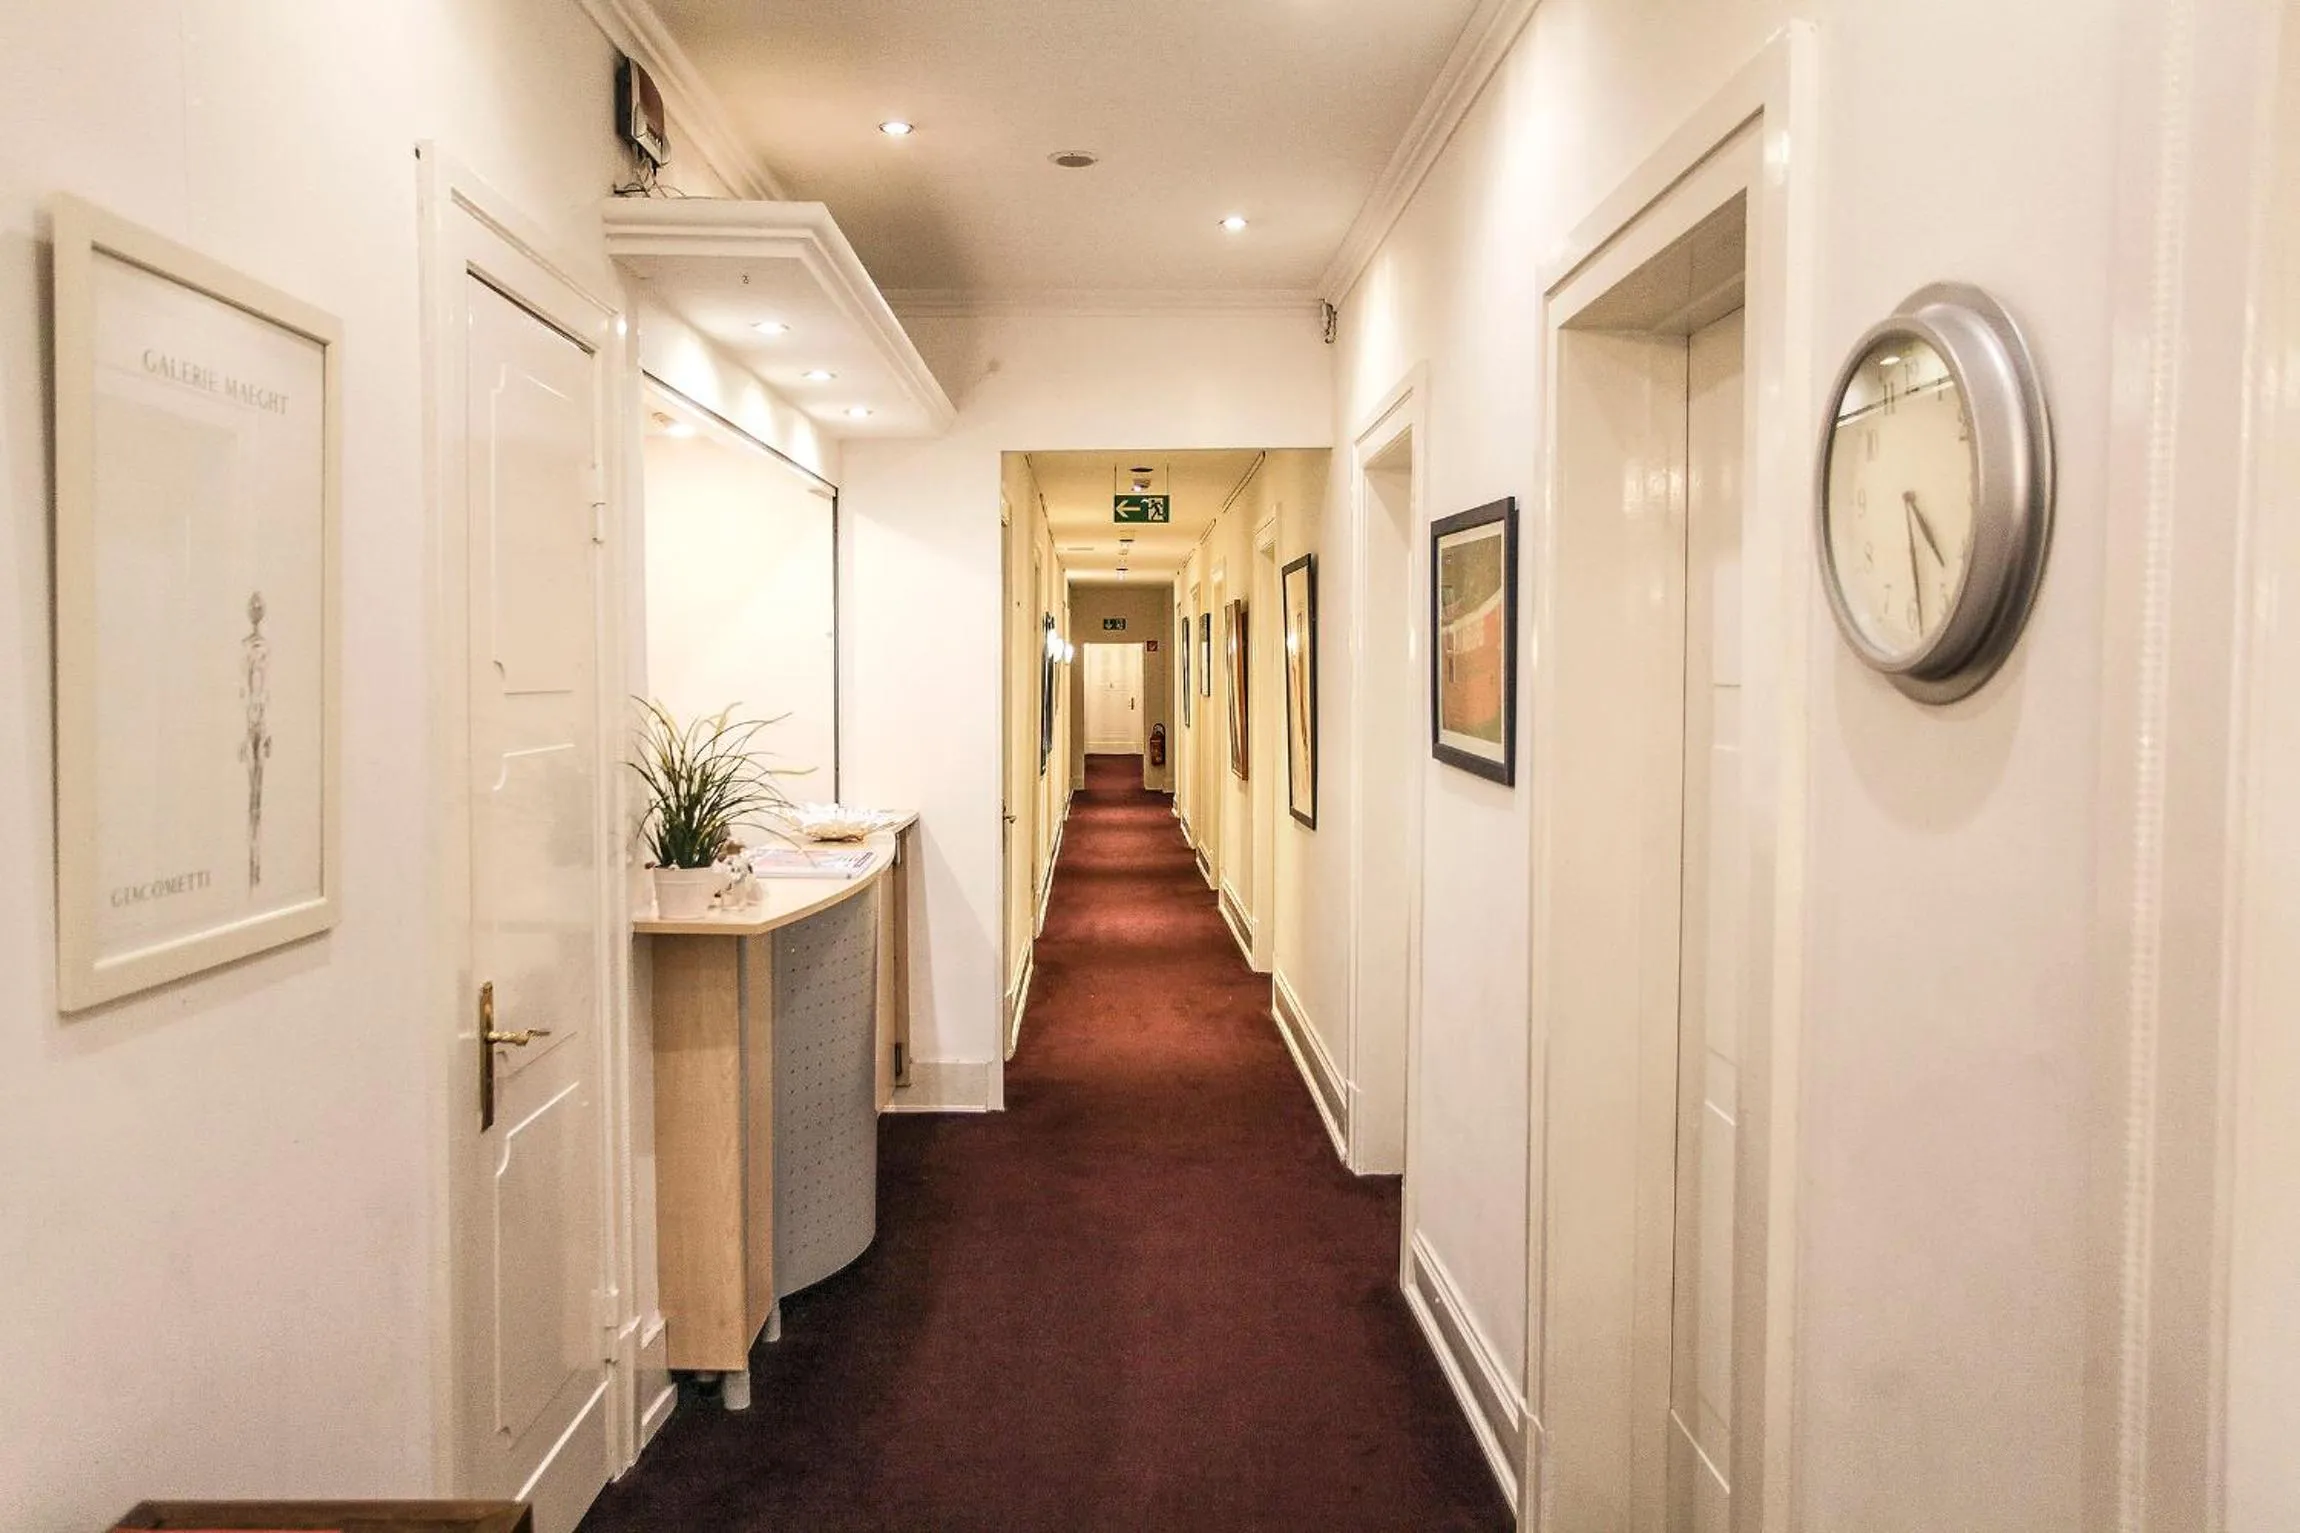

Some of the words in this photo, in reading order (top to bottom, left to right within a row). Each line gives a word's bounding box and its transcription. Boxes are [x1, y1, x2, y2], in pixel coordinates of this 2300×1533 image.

[142, 348, 219, 392] GALERIE
[224, 375, 290, 415] MAEGHT
[109, 870, 212, 909] GIACOMETTI
